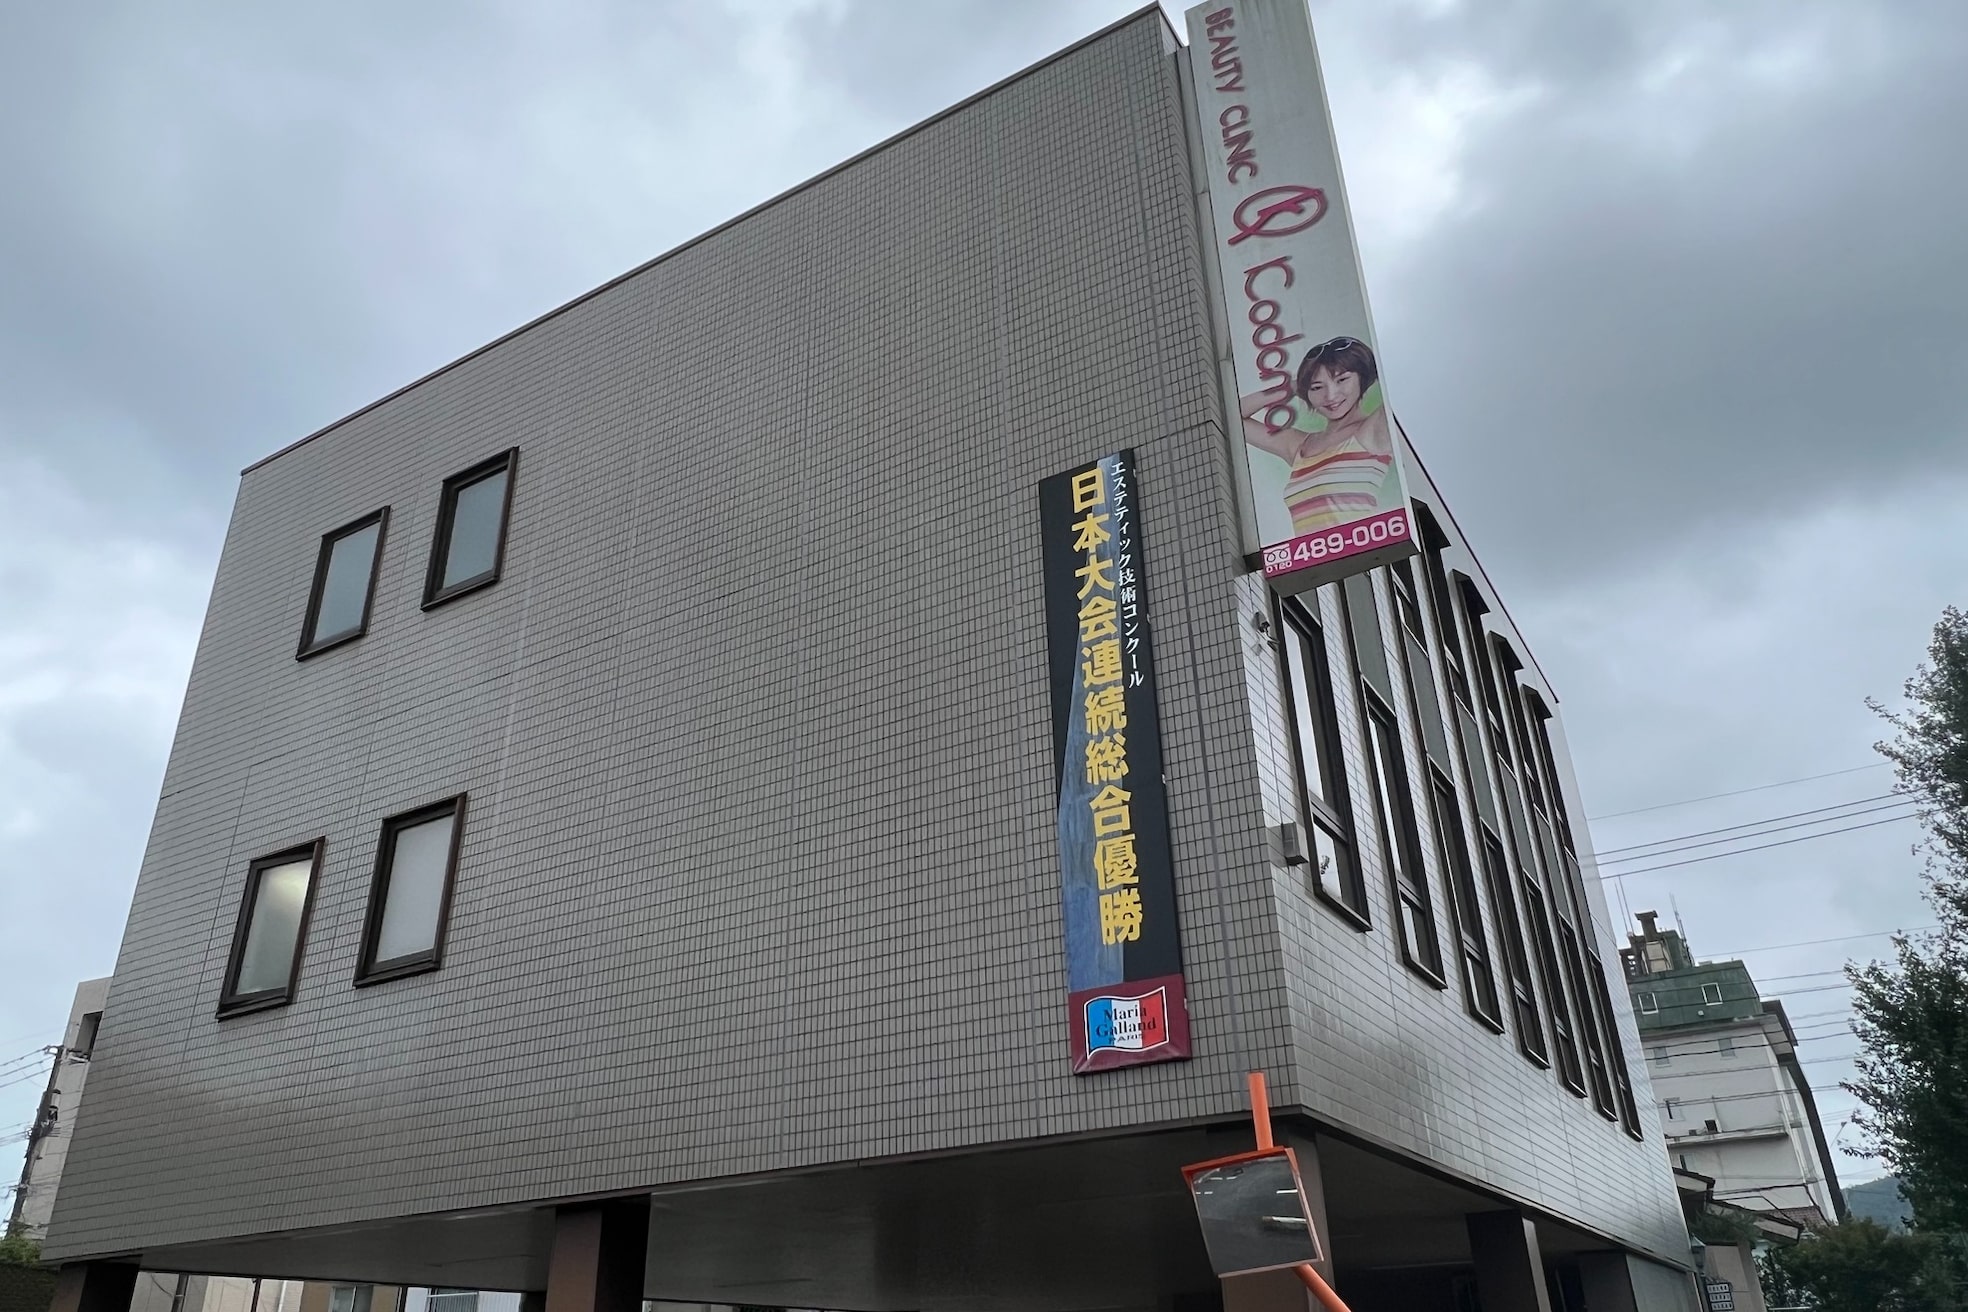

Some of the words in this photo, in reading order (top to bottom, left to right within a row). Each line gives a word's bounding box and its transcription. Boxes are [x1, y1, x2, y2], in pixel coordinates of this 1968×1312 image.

[1205, 7, 1245, 93] BEAUTY
[1219, 104, 1258, 185] CLINIC
[1293, 516, 1406, 562] 489-006
[1111, 461, 1145, 689] エステティック技術コンクール
[1266, 561, 1293, 573] 0120
[1071, 468, 1143, 945] 日本大会連続総合優勝
[1096, 1017, 1157, 1037] Galland
[1104, 1004, 1147, 1022] Maria
[1109, 1033, 1143, 1043] PARIS
